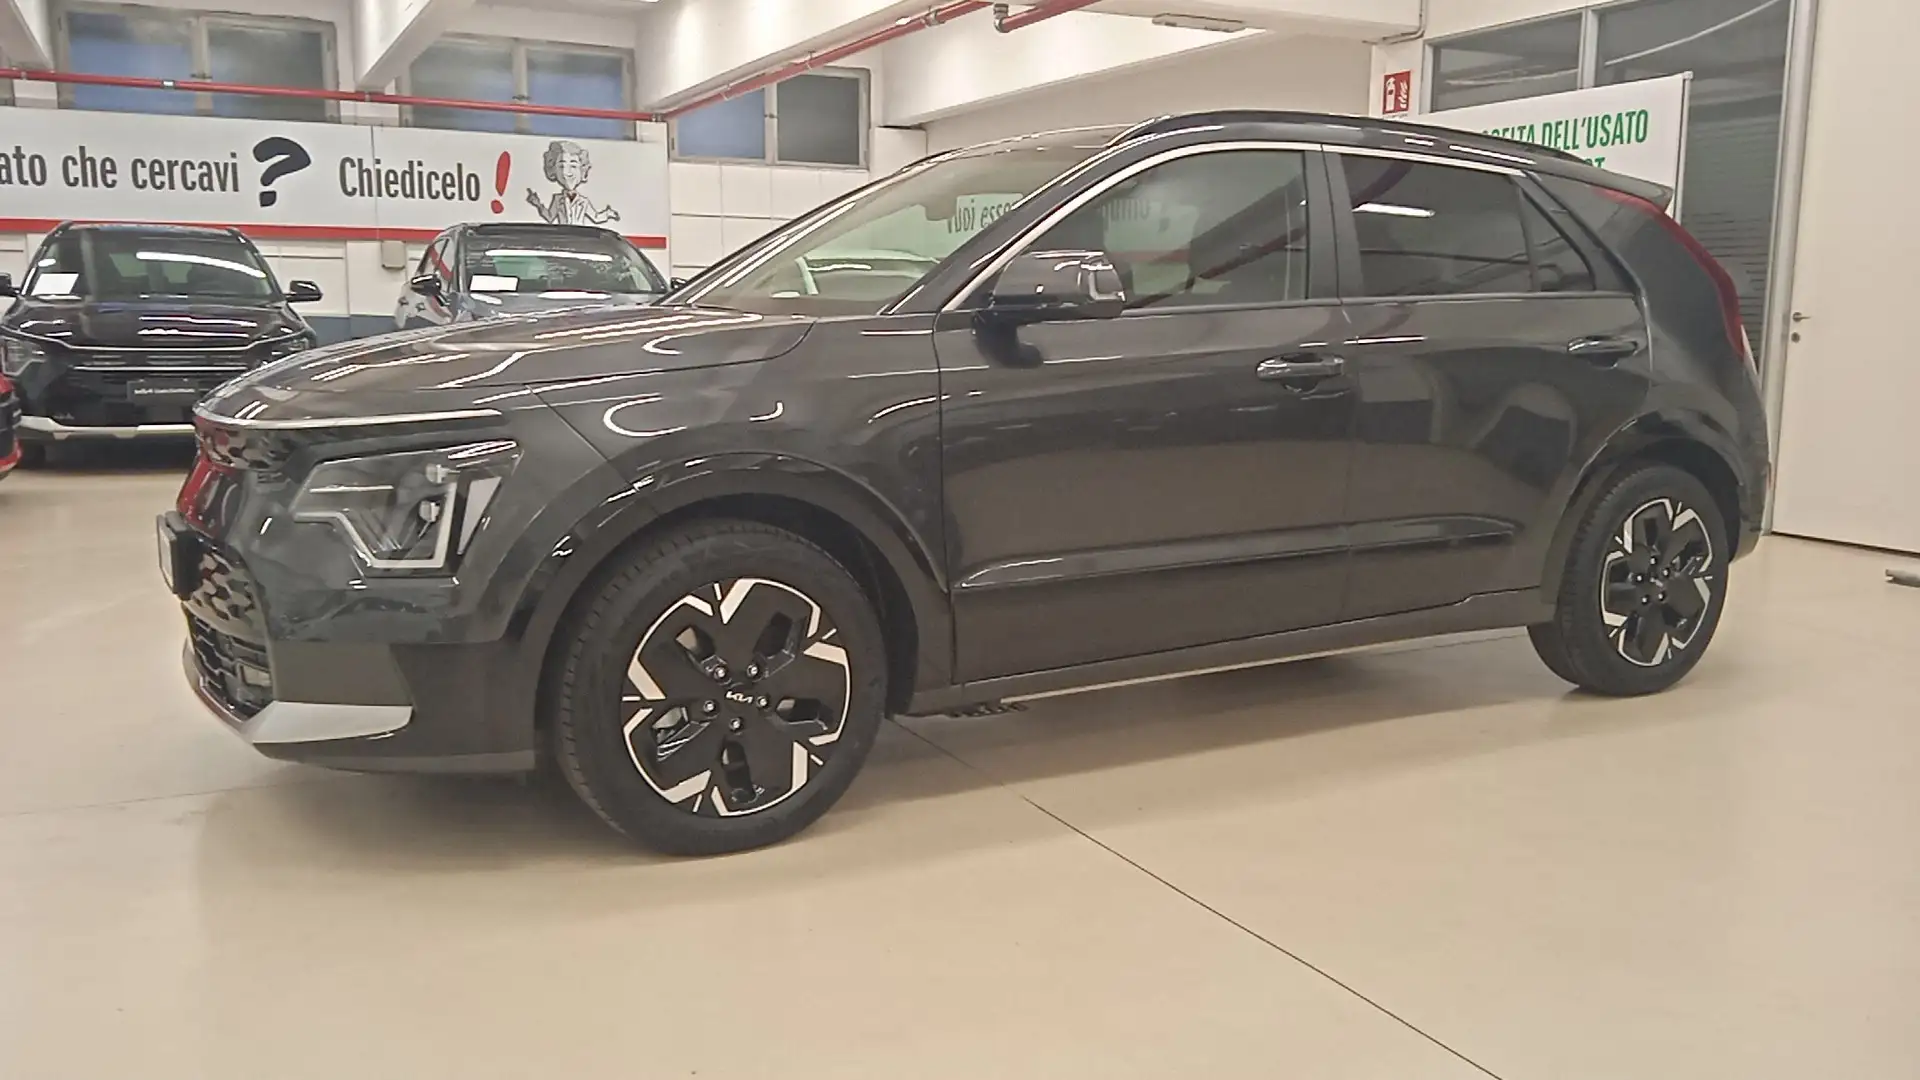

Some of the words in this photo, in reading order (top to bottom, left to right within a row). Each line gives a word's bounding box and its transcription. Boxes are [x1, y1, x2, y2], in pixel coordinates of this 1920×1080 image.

[1542, 109, 1649, 150] DELL'USATO
[62, 145, 118, 189] che
[131, 152, 239, 192] cercavi
[339, 156, 481, 202] Chiedicelo
